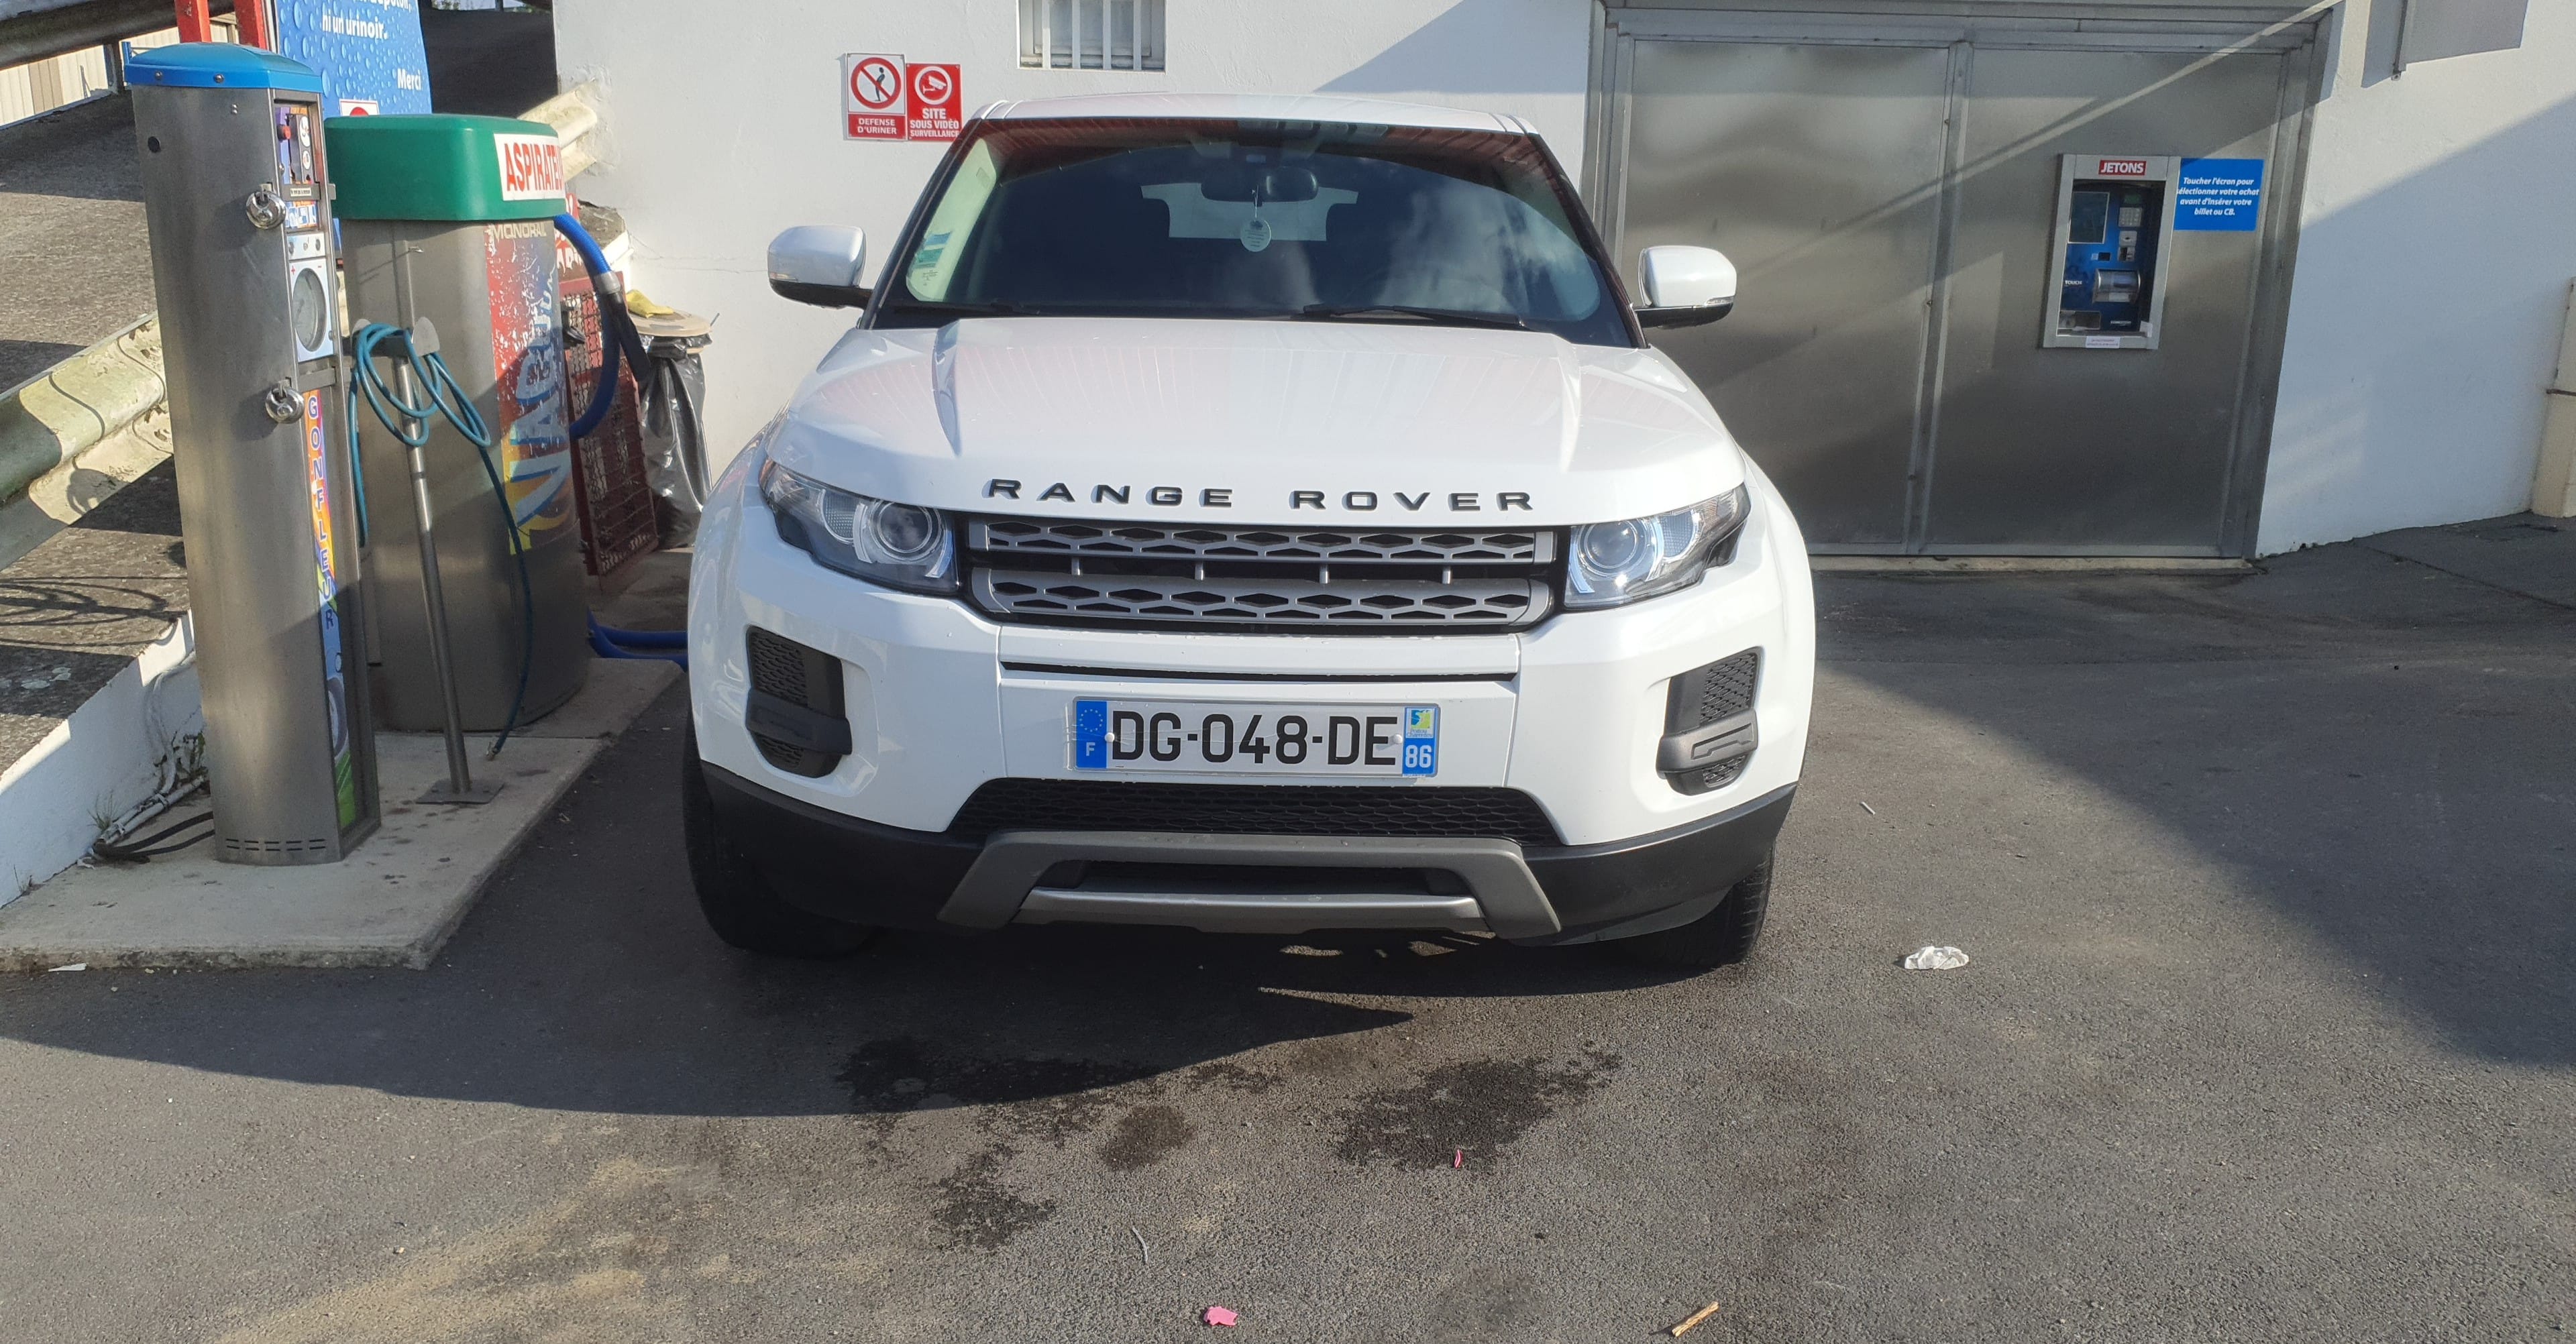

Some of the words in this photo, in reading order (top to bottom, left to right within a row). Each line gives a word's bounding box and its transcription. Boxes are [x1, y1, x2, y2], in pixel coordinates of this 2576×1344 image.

[322, 9, 331, 32] ni
[333, 15, 344, 34] un
[345, 13, 389, 40] urinoir.
[397, 68, 422, 91] Merci
[922, 108, 946, 119] SITE
[858, 117, 896, 126] DEFENSE
[910, 119, 932, 129] SOUS
[857, 126, 897, 135] D'URINER
[910, 129, 959, 137] SURVEILLANCE
[2100, 162, 2144, 174] JETONS
[2184, 177, 2212, 185] Toucher
[2212, 177, 2236, 185] l'écran
[2176, 187, 2218, 195] sélectionner
[2239, 188, 2260, 196] achat
[2202, 197, 2233, 206] d'insérer
[989, 478, 1233, 508] RANGE
[1293, 490, 1535, 513] ROVER
[307, 396, 335, 630] GONFLEUR
[1112, 710, 1398, 766] DG-048-DE
[1085, 742, 1095, 757] F
[1405, 744, 1432, 768] 86
